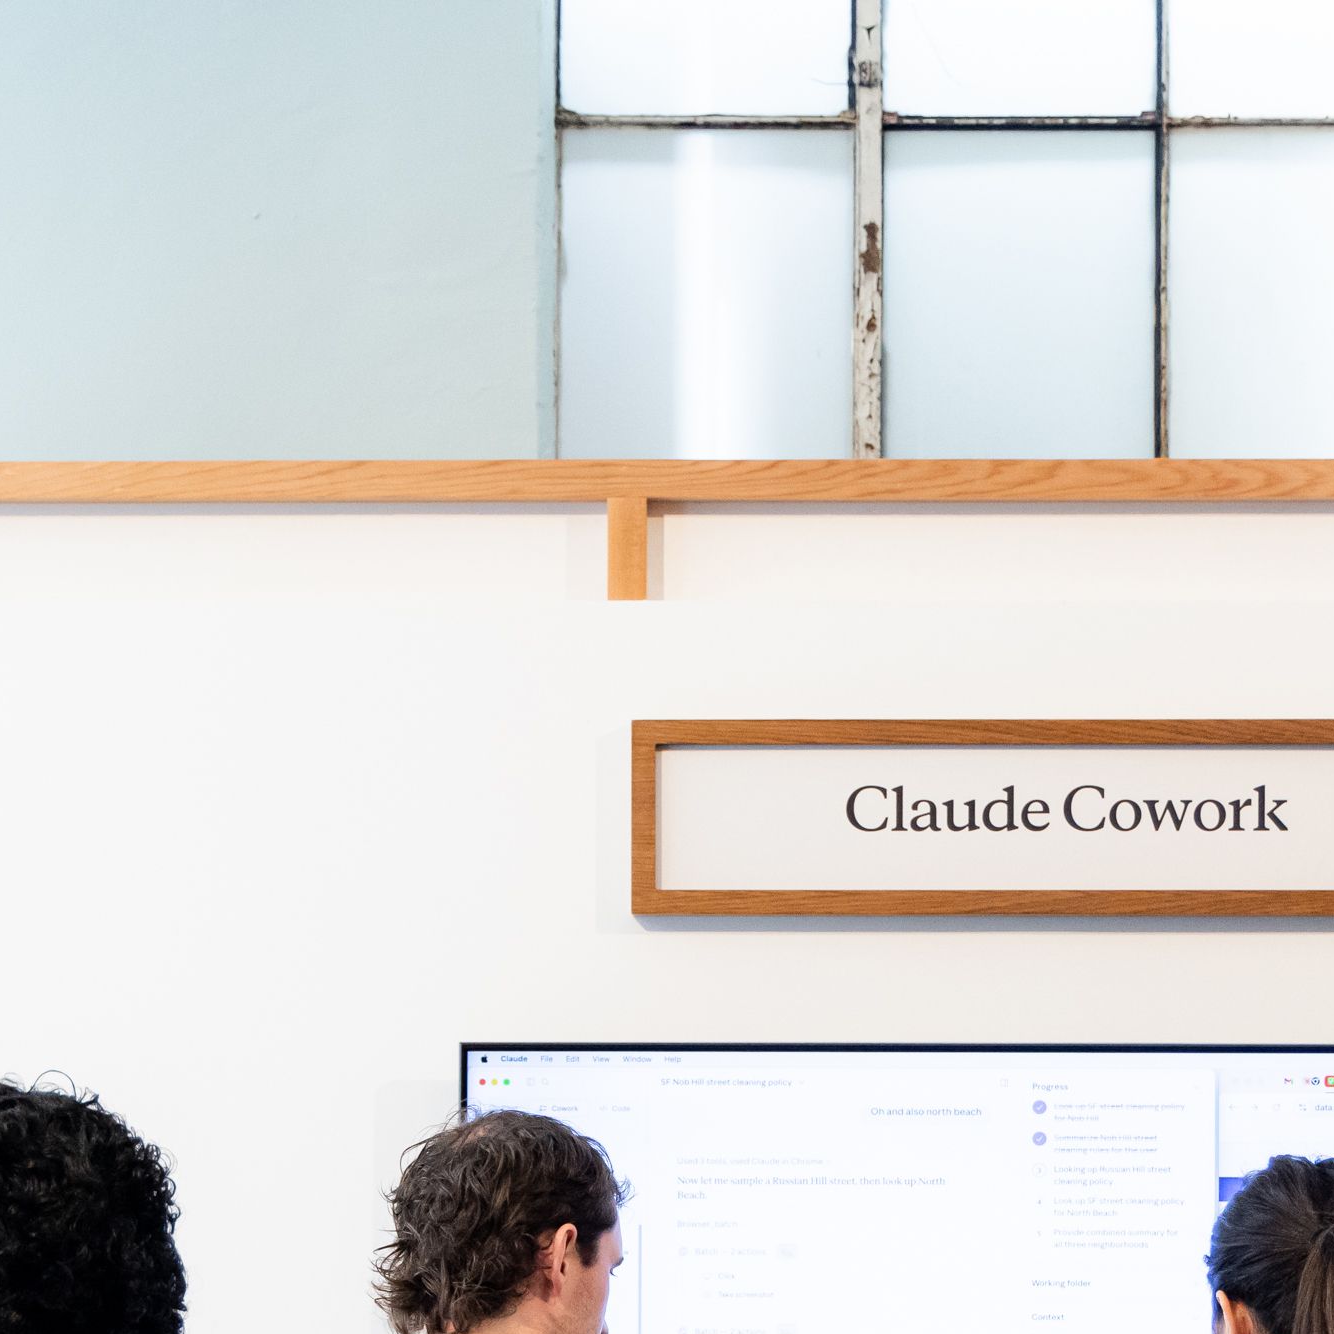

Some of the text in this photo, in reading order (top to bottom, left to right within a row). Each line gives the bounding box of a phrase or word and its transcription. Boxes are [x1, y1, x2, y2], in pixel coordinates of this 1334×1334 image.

[845, 785, 1289, 832] Claude Cowork
[500, 1055, 682, 1065] Claude File Edit View Window Help
[659, 1078, 793, 1089] SF Nob Hill street cleaning policy
[1031, 1082, 1069, 1092] Progress
[869, 1107, 983, 1116] Oh and also north beach
[1053, 1165, 1086, 1176] Looking
[1086, 1167, 1098, 1176] up
[1099, 1165, 1131, 1174] Russian
[1132, 1165, 1146, 1174] Hill
[1146, 1165, 1172, 1174] street
[676, 1176, 699, 1185] Now
[700, 1176, 713, 1185] let
[730, 1176, 764, 1187] sample
[772, 1176, 810, 1185] Russian
[810, 1176, 829, 1185] Hill
[828, 1176, 857, 1185] street,
[859, 1176, 881, 1185] then
[881, 1176, 904, 1185] look
[904, 1178, 917, 1187] up
[917, 1176, 947, 1185] North
[1053, 1178, 1114, 1188] cleaning policy
[676, 1190, 707, 1200] Beach.
[1125, 1198, 1159, 1207] cleaning
[1160, 1198, 1185, 1207] policy
[1126, 1230, 1165, 1238] summary
[1087, 1241, 1149, 1250] neighborhoods
[1031, 1280, 1066, 1288] Working
